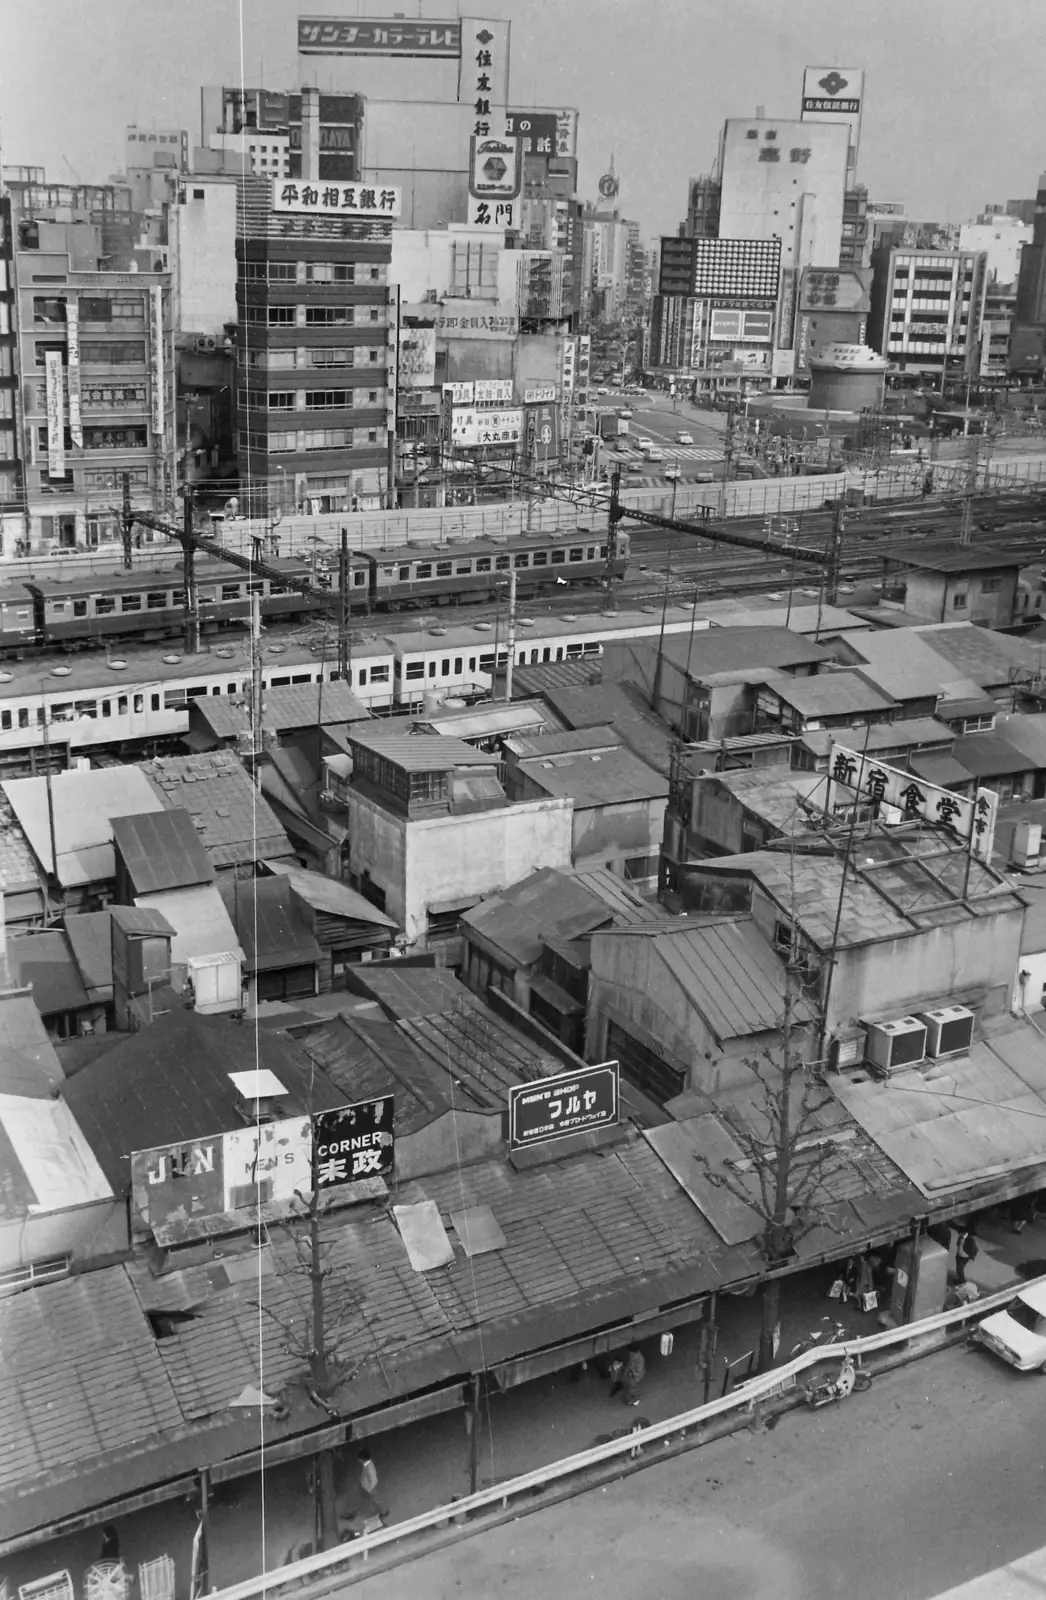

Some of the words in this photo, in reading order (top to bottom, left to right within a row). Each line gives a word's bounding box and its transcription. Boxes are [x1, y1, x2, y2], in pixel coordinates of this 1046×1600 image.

[301, 26, 459, 46] サンヨーカラーテレビ
[475, 49, 493, 136] 住友銀行
[281, 184, 397, 211] 平和相互銀行
[474, 202, 513, 226] 名門
[833, 752, 962, 826] 新宿食堂
[553, 1084, 579, 1097] SHOP
[548, 1090, 596, 1119] フルヤ
[318, 1132, 382, 1156] CORNER
[318, 1149, 382, 1184] 末政
